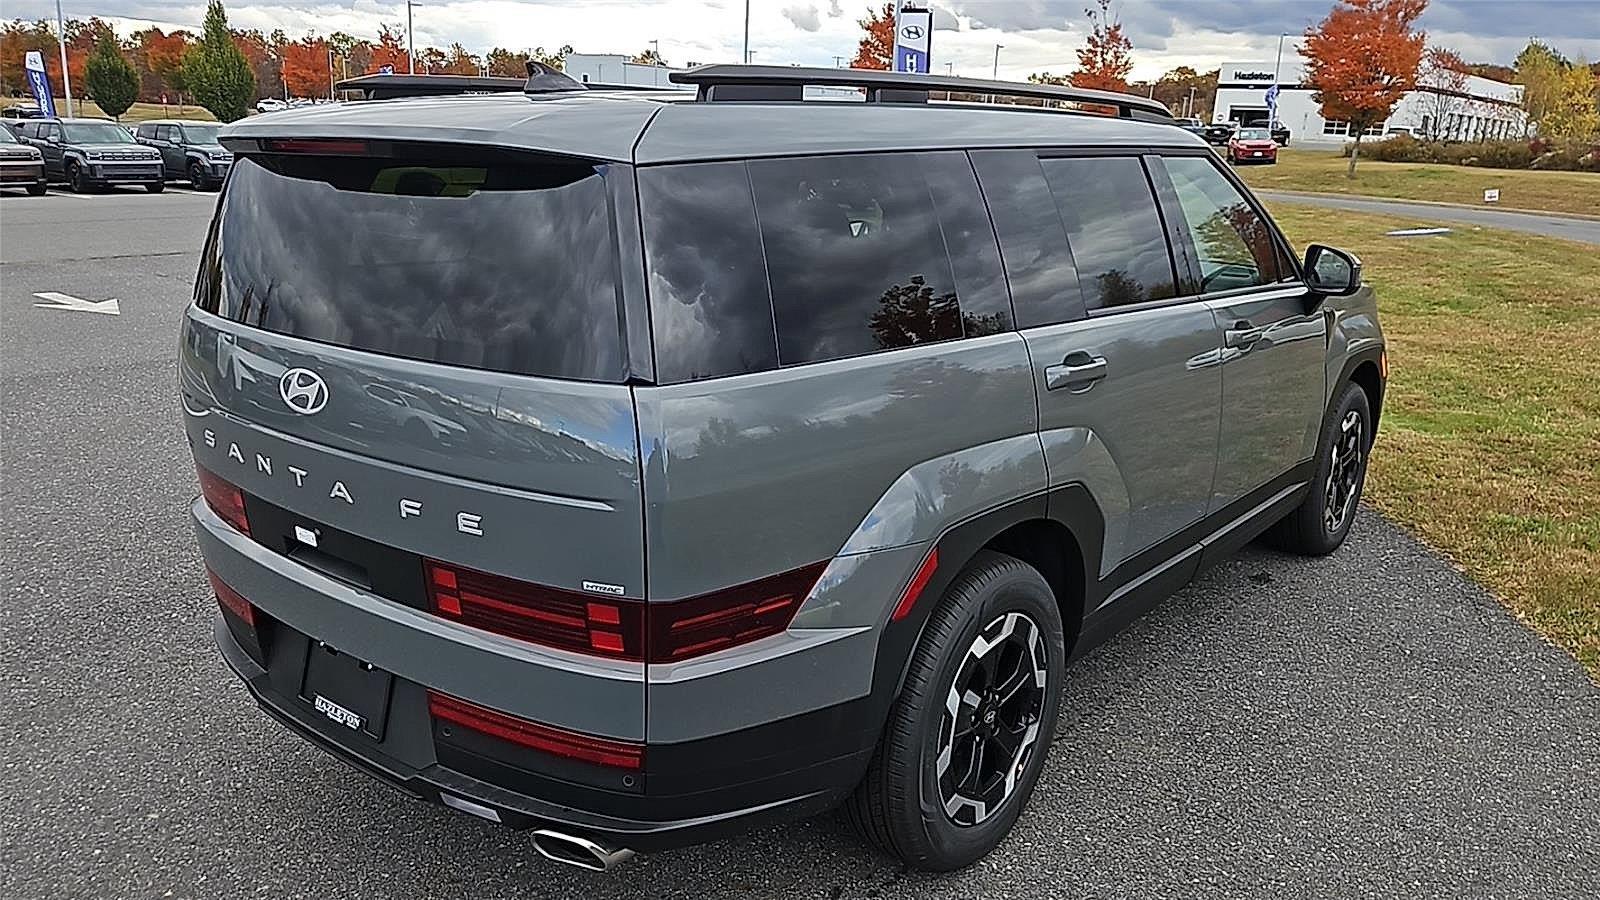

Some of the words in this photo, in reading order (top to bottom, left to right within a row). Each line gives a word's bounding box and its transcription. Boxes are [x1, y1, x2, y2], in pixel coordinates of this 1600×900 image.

[1233, 71, 1275, 81] Hazleton
[203, 428, 354, 505] SANTA
[399, 498, 484, 537] FE
[314, 697, 361, 728] HAZLETON
